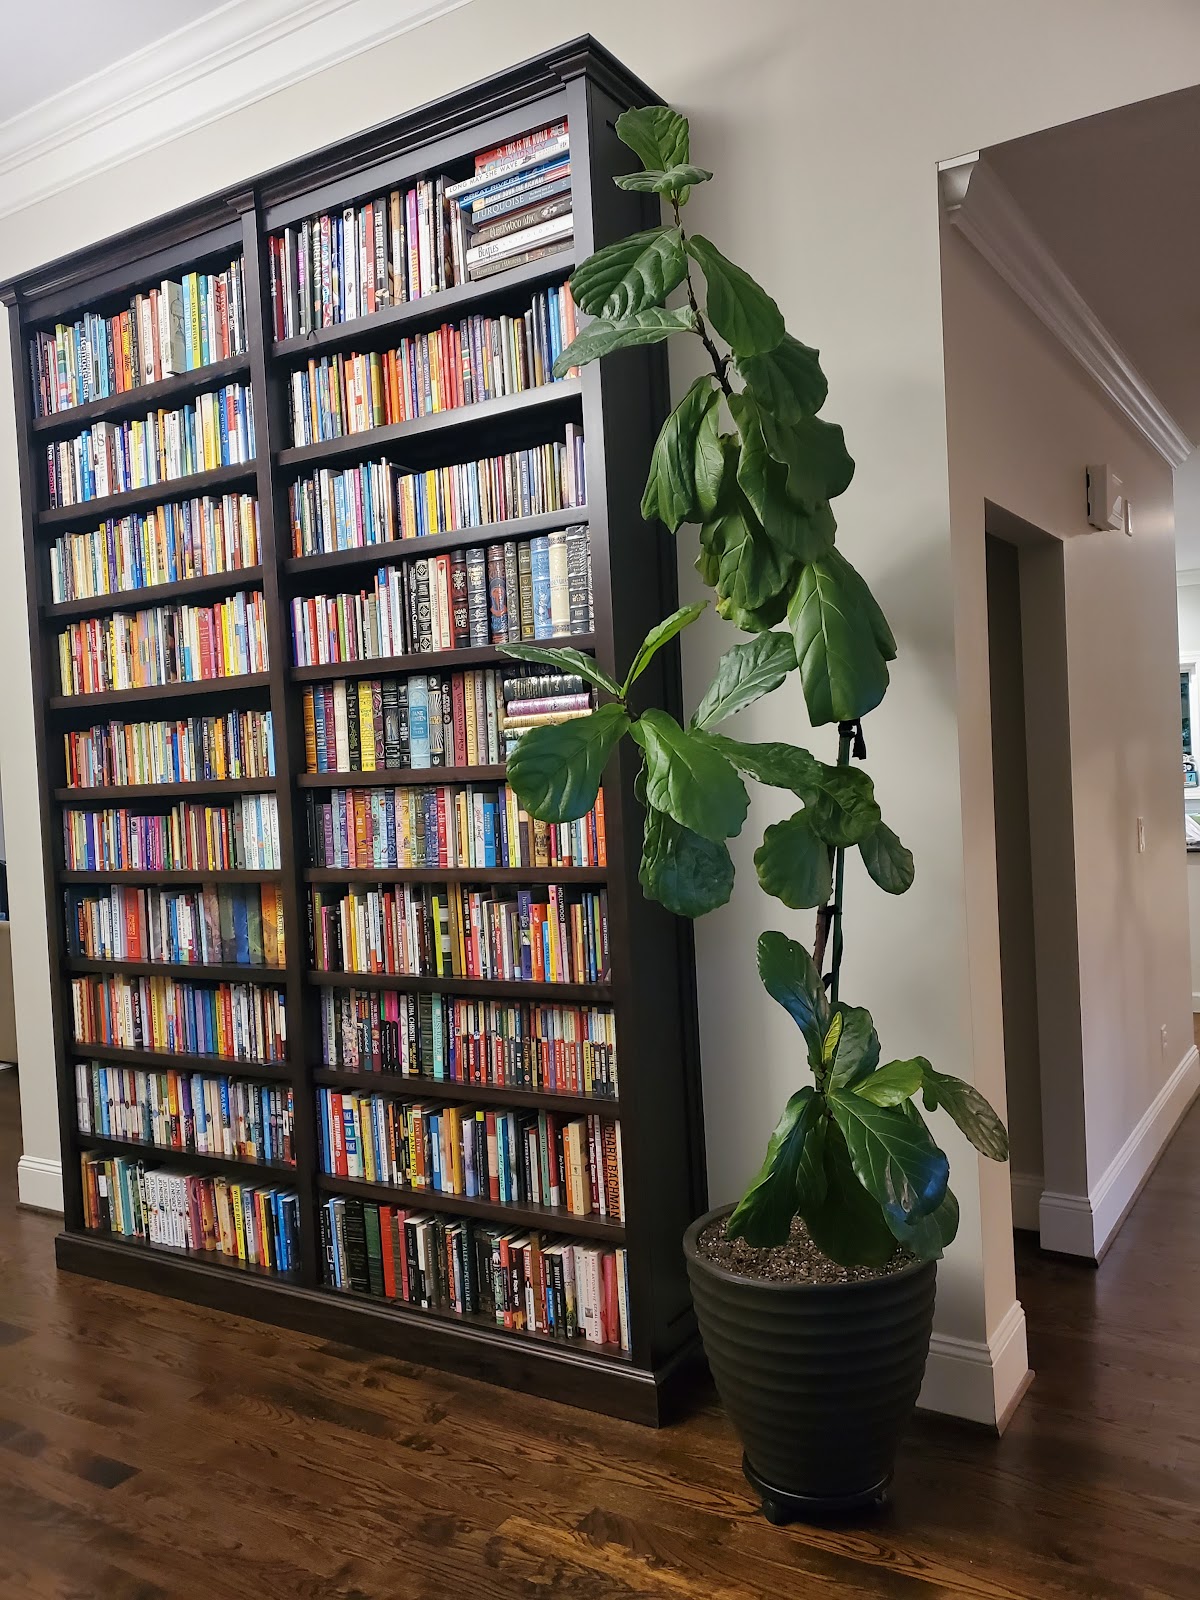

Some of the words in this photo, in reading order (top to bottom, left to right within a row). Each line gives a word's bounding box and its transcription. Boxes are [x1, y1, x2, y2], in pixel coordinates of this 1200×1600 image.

[449, 182, 467, 193] LONG
[469, 174, 483, 185] MAY
[486, 169, 498, 179] SHE
[500, 161, 518, 173] WAVE
[463, 188, 489, 201] GREAT
[490, 176, 520, 192] RIVERS
[476, 196, 525, 219] TURQUOISE
[374, 224, 383, 248] BOOK
[490, 219, 521, 238] FLEETWOOD
[522, 213, 535, 226] MAC
[343, 227, 351, 276] MYTHOLOGY
[478, 244, 499, 258] BEATLES
[376, 256, 384, 279] ROCK
[410, 247, 419, 291] HENDRIX
[79, 336, 90, 399] Remodelista
[408, 1017, 416, 1042] CHRISTIE
[333, 1114, 341, 1150] ENTERTAINMENT
[607, 1163, 619, 1219] BACHMAN
